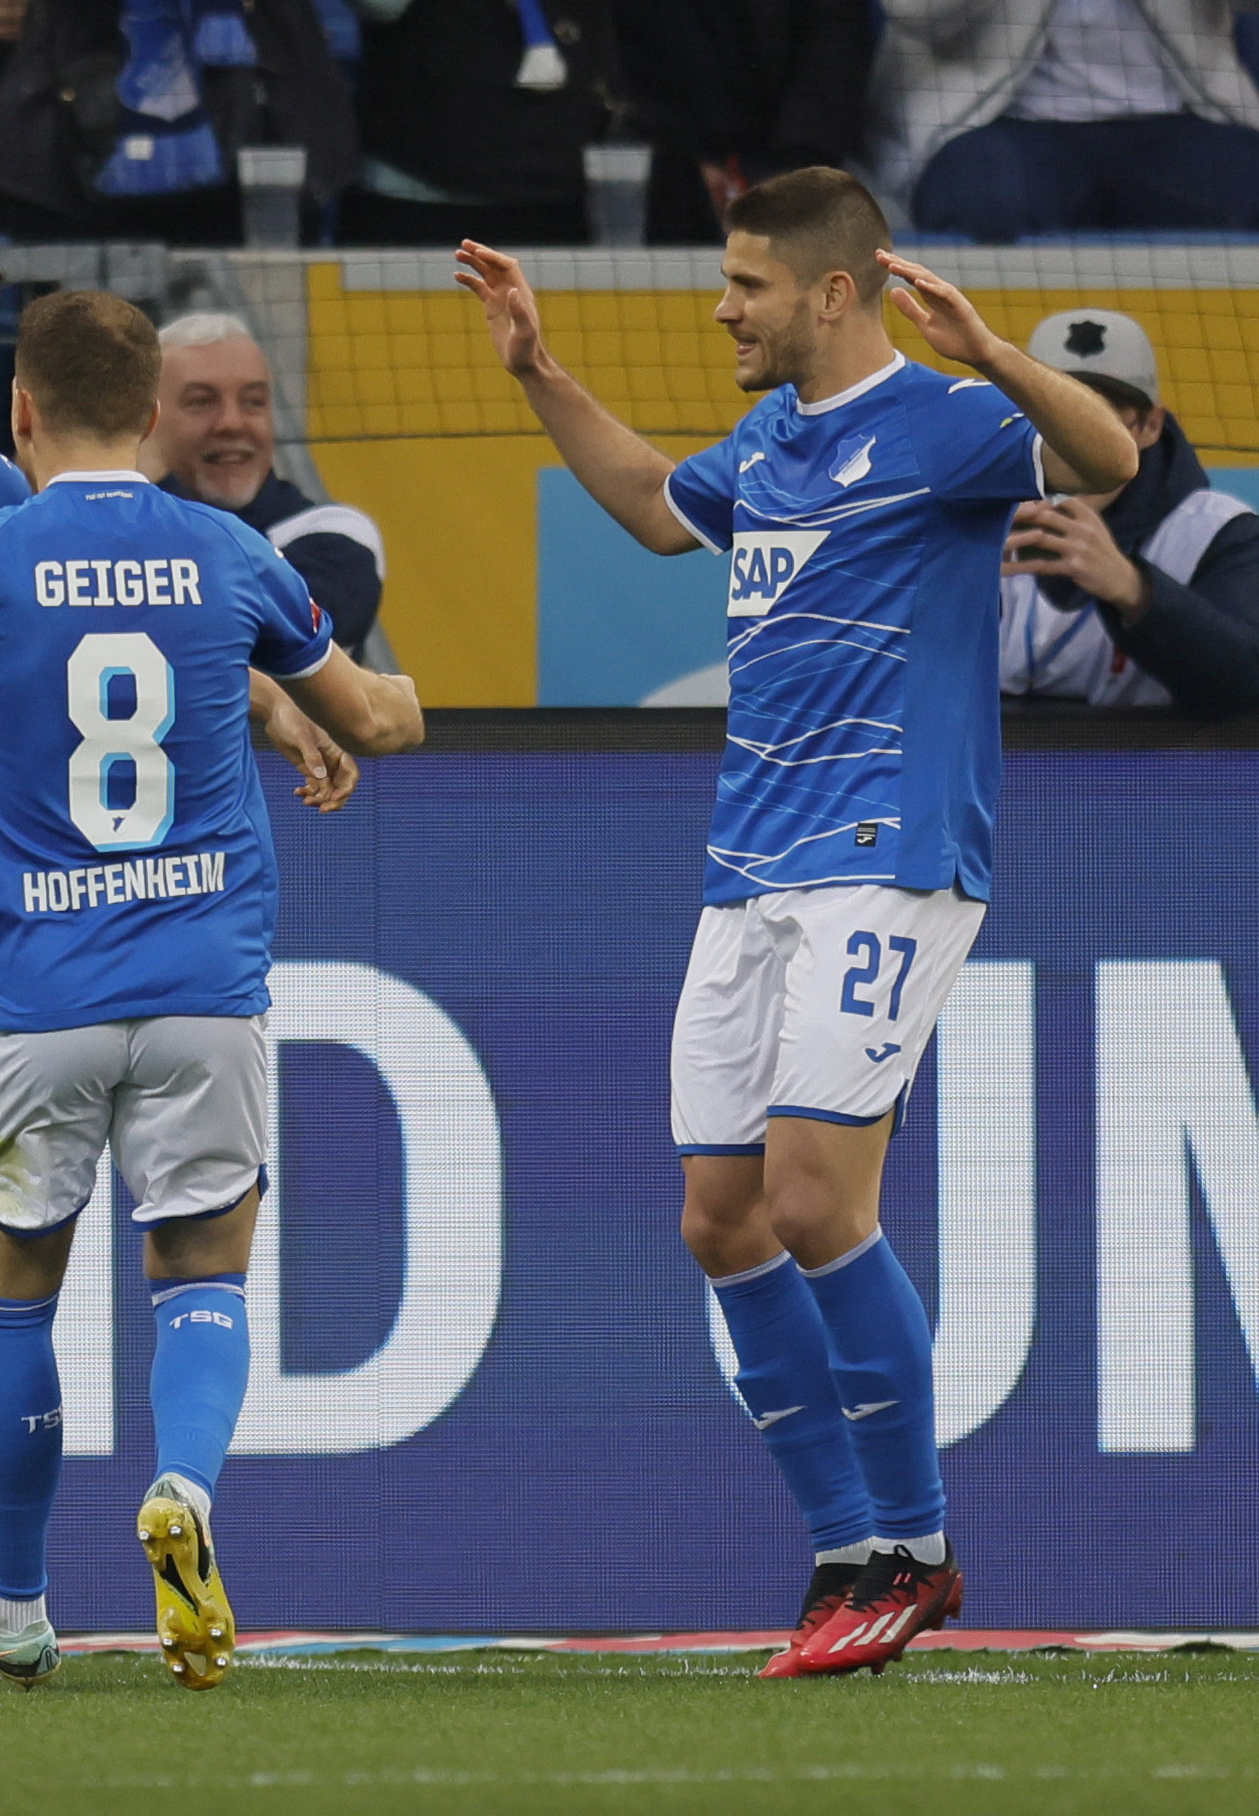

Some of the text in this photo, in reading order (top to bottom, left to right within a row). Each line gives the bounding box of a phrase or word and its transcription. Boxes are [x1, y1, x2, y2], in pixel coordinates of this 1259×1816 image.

[35, 559, 202, 607] GEIGER
[731, 547, 794, 600] SAP
[67, 632, 175, 853] 8
[23, 852, 225, 912] HOFFENHEIM
[840, 930, 917, 1021] 27
[169, 1310, 234, 1330] TSG
[21, 1402, 63, 1434] TS
